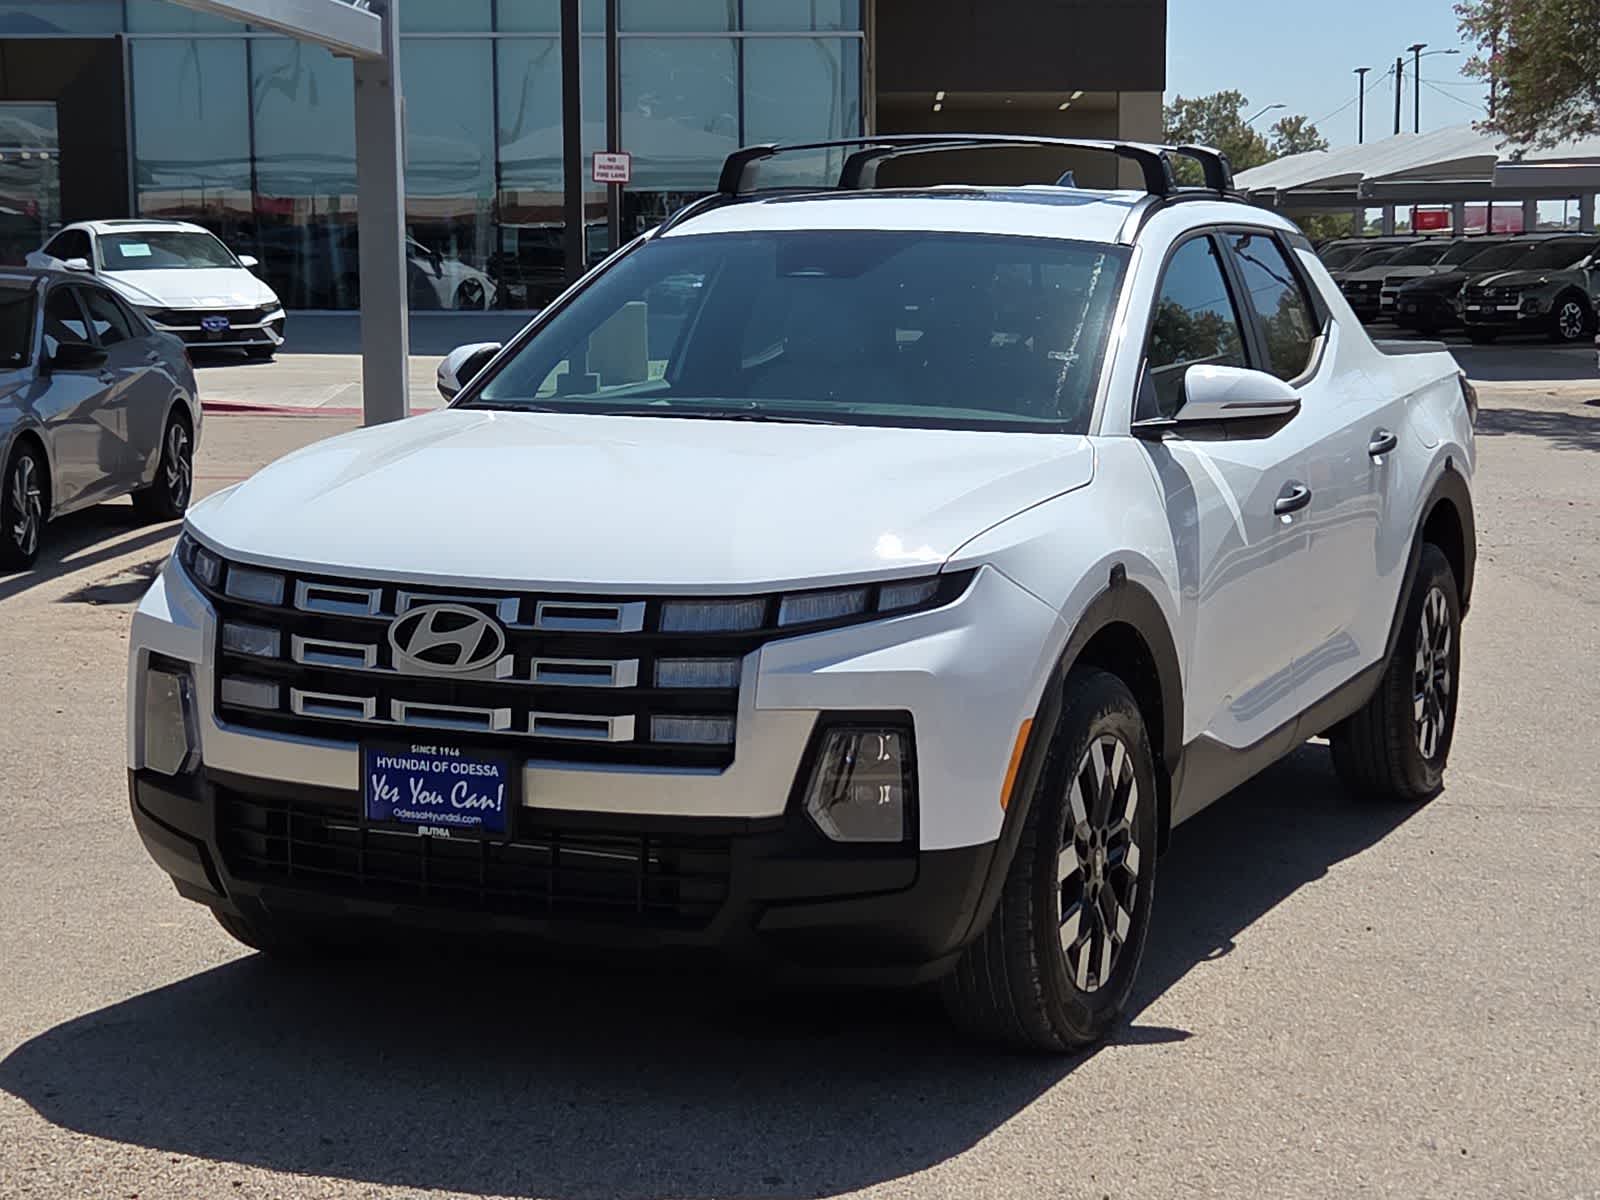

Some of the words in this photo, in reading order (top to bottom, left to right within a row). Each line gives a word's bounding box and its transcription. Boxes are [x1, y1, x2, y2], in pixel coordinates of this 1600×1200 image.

[411, 744, 437, 756] SINCE
[376, 756, 430, 771] HYUNDAI
[431, 761, 449, 773] OF
[450, 762, 499, 777] ODESSA
[371, 773, 400, 803] Yes
[409, 777, 444, 805] You
[450, 780, 505, 812] Can!
[393, 807, 482, 825] OdessaHyundai.com
